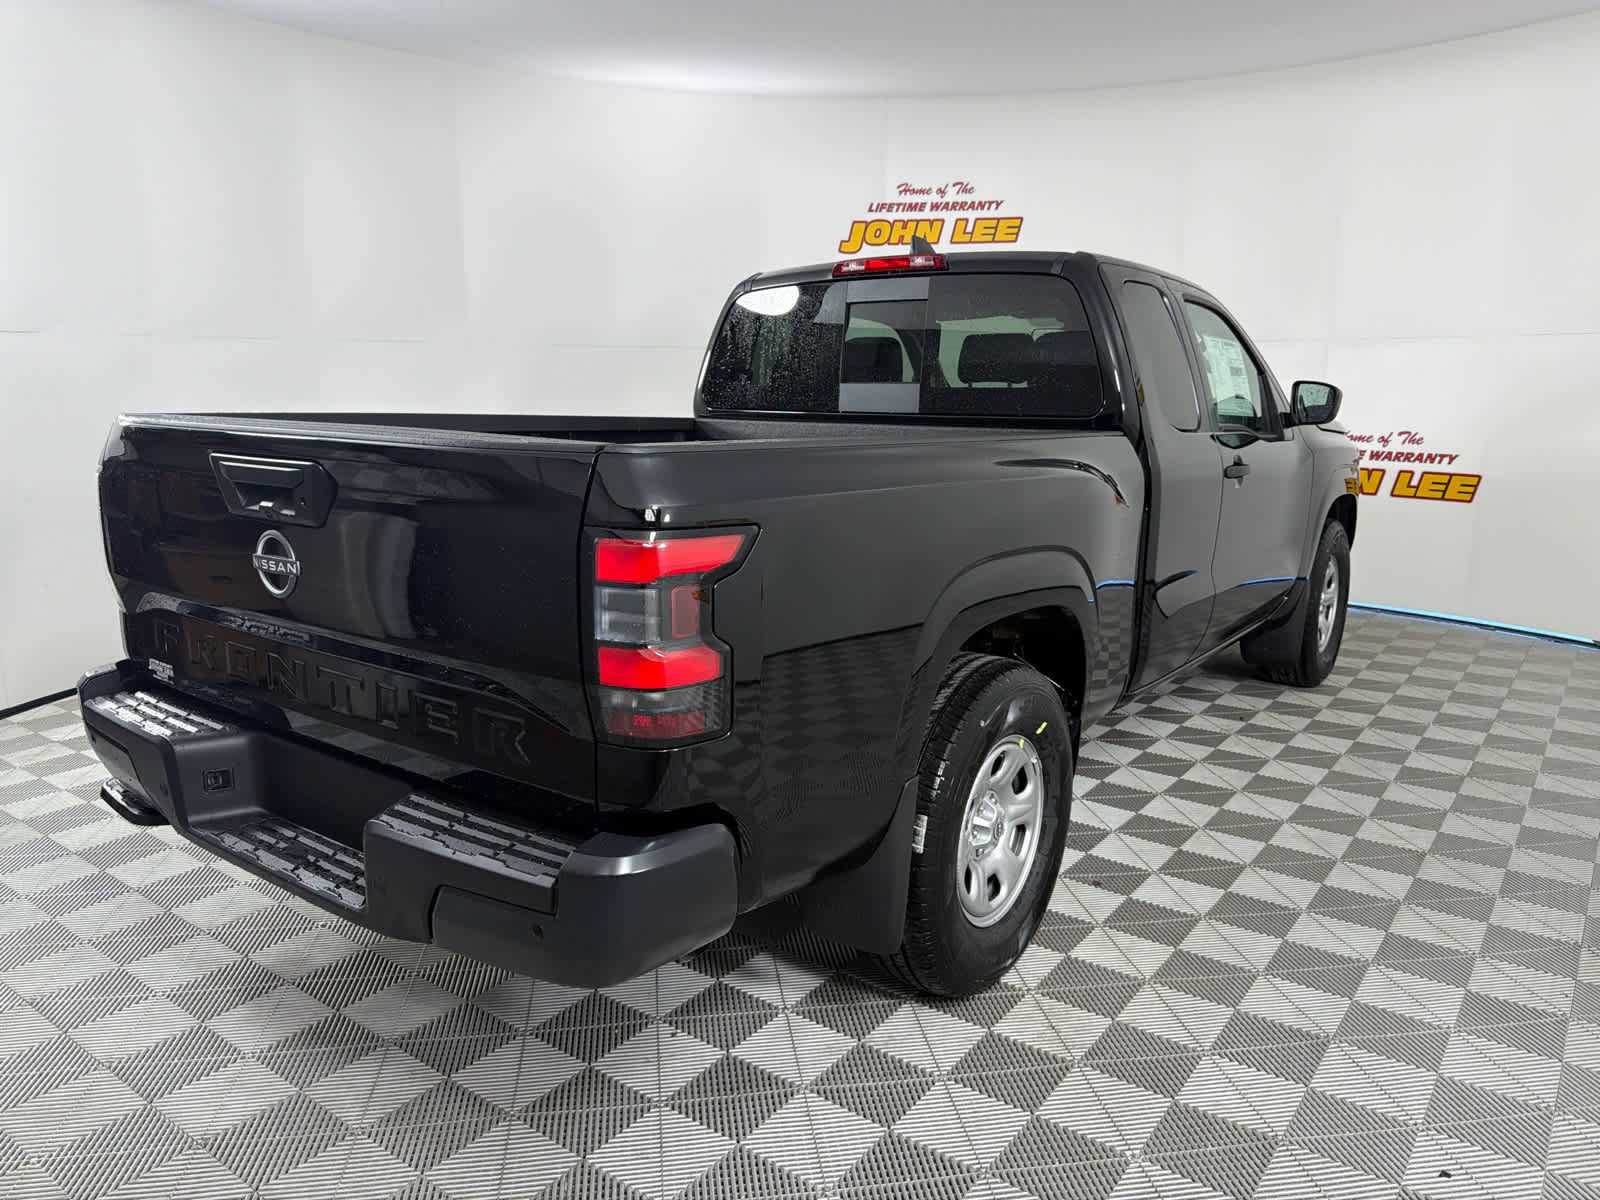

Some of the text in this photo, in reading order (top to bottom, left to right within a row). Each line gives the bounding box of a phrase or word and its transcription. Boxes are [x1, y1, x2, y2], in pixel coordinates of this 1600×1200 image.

[896, 181, 976, 198] Home of The
[867, 200, 1004, 213] LIFETIME WARRANTY
[838, 216, 1023, 254] JOHN LEE
[1344, 430, 1424, 447] ome of The
[1369, 450, 1459, 464] WARRANTY
[1390, 470, 1482, 503] LEE
[253, 555, 297, 574] NISSAN
[153, 617, 532, 768] FRONTIER
